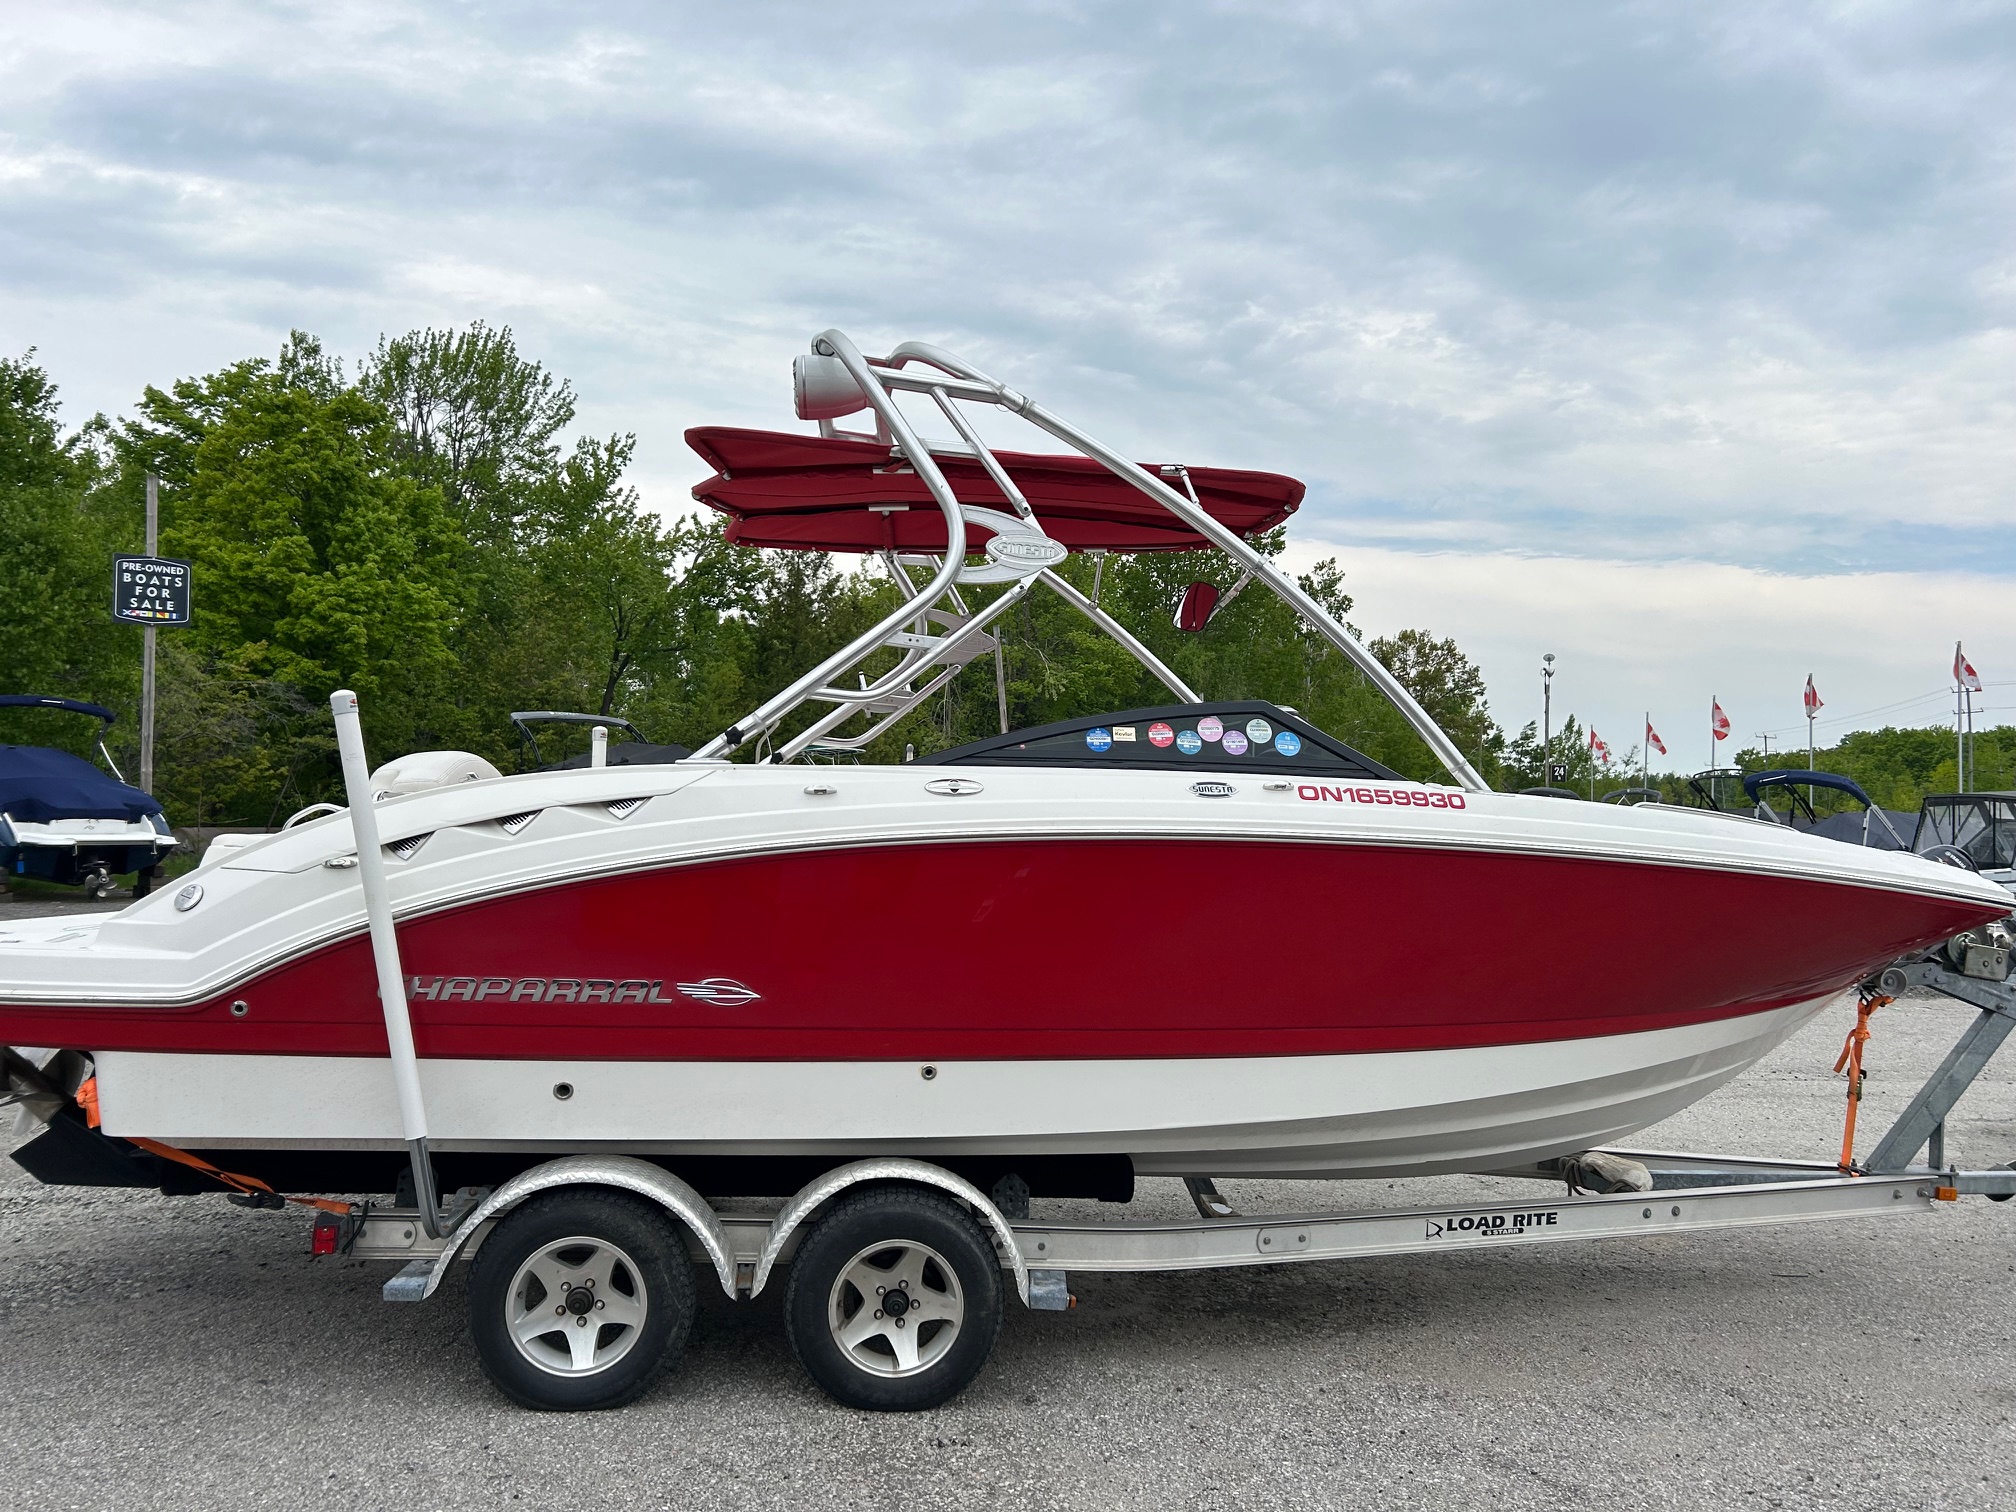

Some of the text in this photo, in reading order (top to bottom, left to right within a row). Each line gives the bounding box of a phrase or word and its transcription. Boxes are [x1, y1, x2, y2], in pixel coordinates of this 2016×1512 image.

[999, 541, 1055, 558] SUNESTA
[122, 562, 184, 575] PRE-OWNED
[123, 573, 182, 588] BOATS
[135, 586, 171, 598] FOR
[130, 597, 175, 611] SALE
[1554, 766, 1565, 776] 24
[1192, 785, 1233, 793] SUNESTA
[1298, 785, 1466, 810] ON1659930
[378, 976, 672, 1005] HAPARRAL
[1446, 1212, 1558, 1231] LOAD RITE
